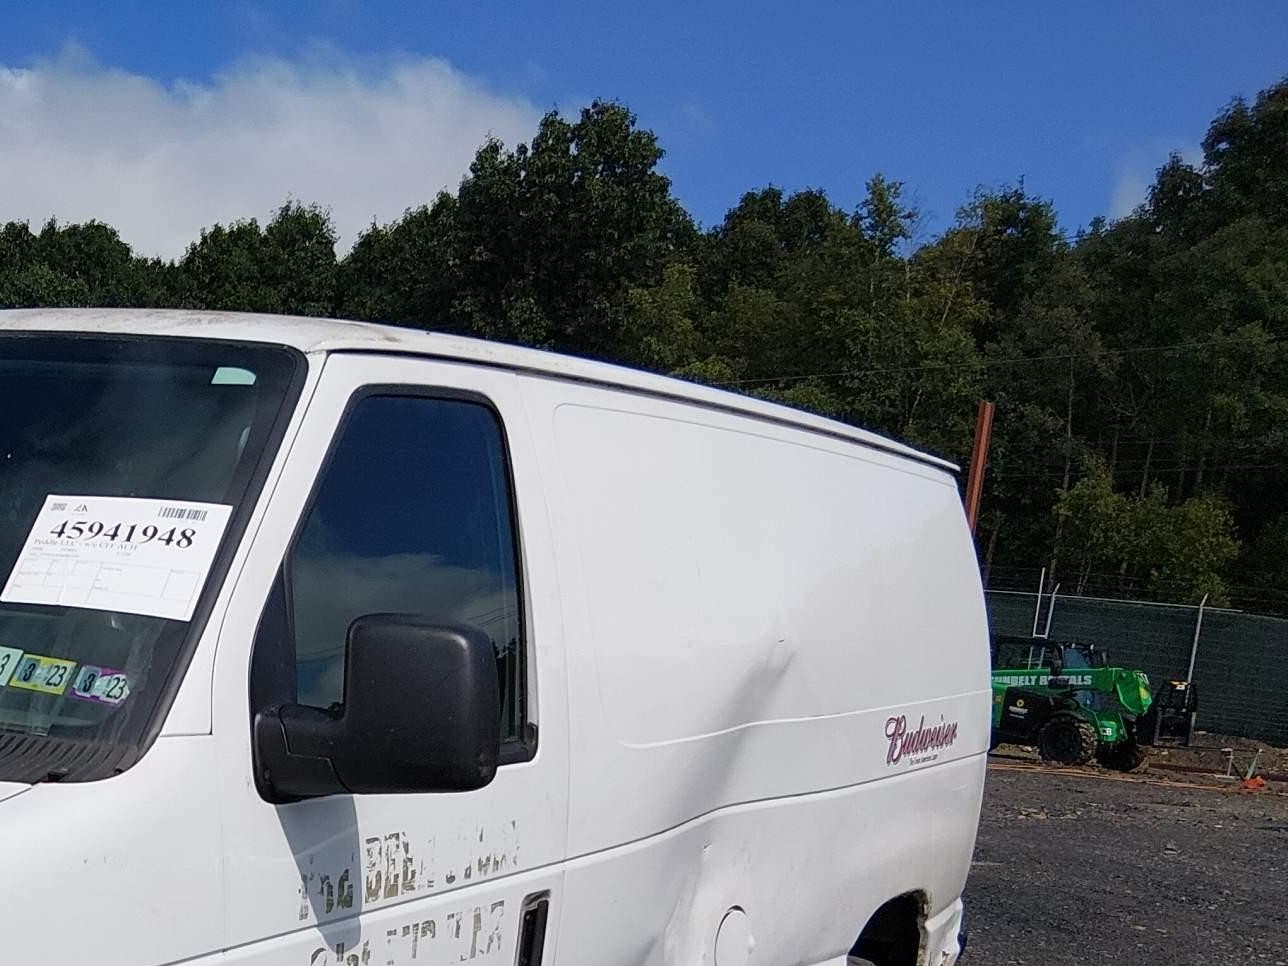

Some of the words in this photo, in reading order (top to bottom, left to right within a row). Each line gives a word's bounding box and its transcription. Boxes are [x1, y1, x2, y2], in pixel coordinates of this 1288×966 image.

[50, 519, 196, 549] 45941948
[23, 663, 36, 682] 3
[45, 665, 67, 687] 23
[83, 673, 96, 693] 3
[106, 677, 128, 700] 23
[1039, 675, 1092, 686] RALS
[885, 714, 958, 766] Budweiser
